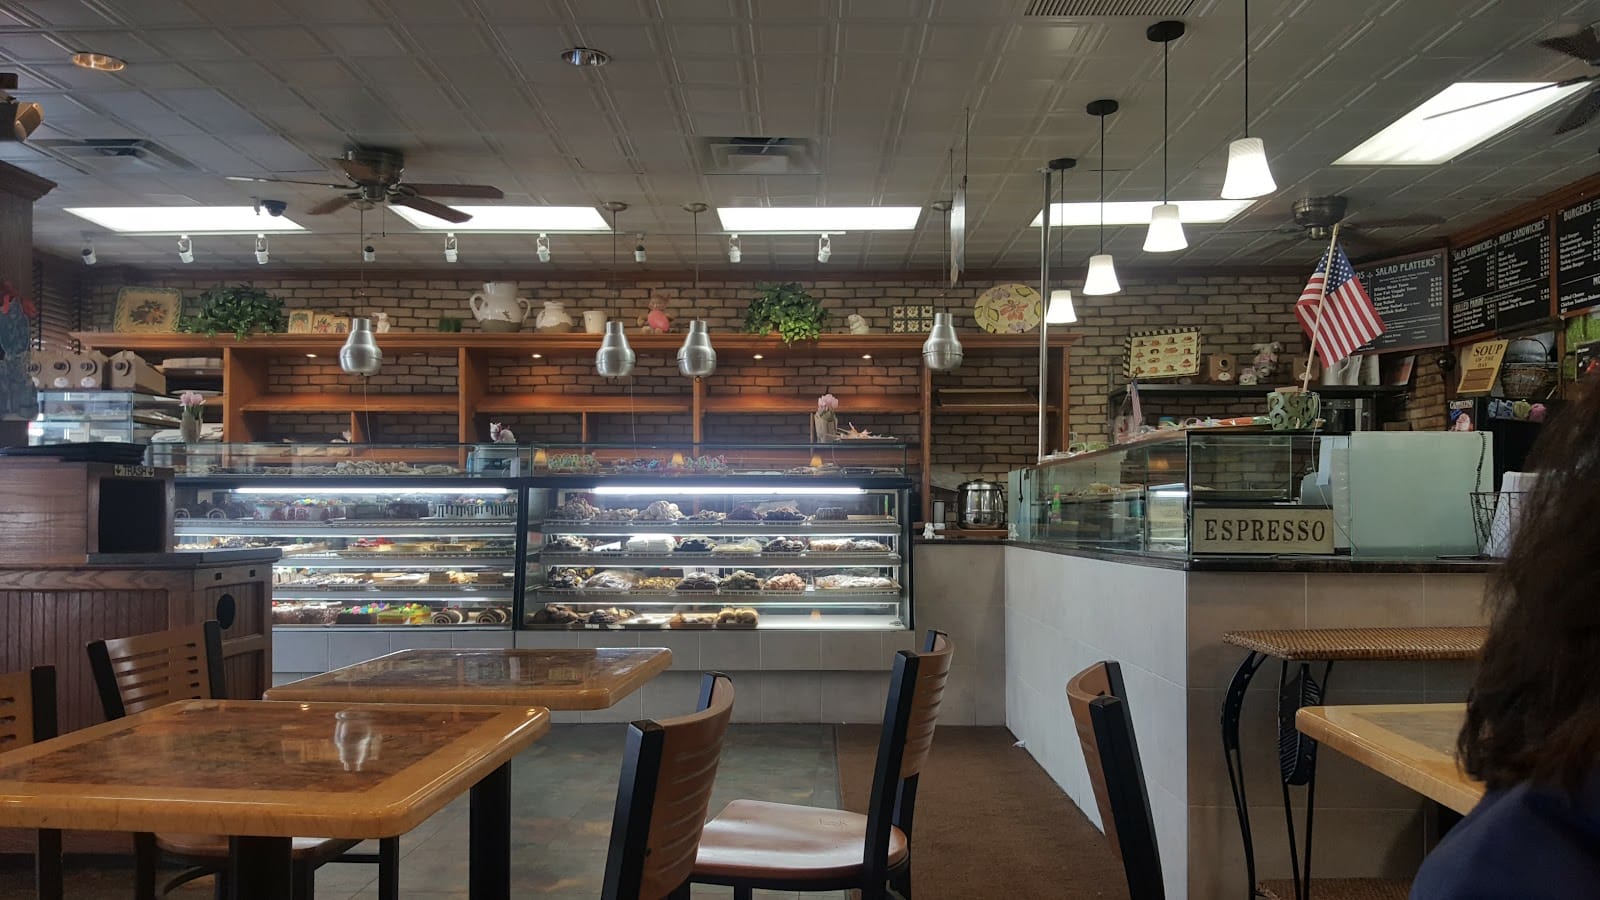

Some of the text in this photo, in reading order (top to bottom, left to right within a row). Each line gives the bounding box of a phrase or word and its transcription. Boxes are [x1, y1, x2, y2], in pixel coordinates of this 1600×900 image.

[1564, 202, 1591, 221] BURGERS
[1499, 232, 1512, 243] MEAT
[1512, 220, 1544, 240] SANDWICHES
[1467, 239, 1492, 256] SANDWICHES
[1375, 266, 1398, 277] SALAD
[1400, 258, 1436, 272] PLATTERS
[1474, 344, 1502, 356] SOUP
[1204, 519, 1325, 542] ESPRESSO
